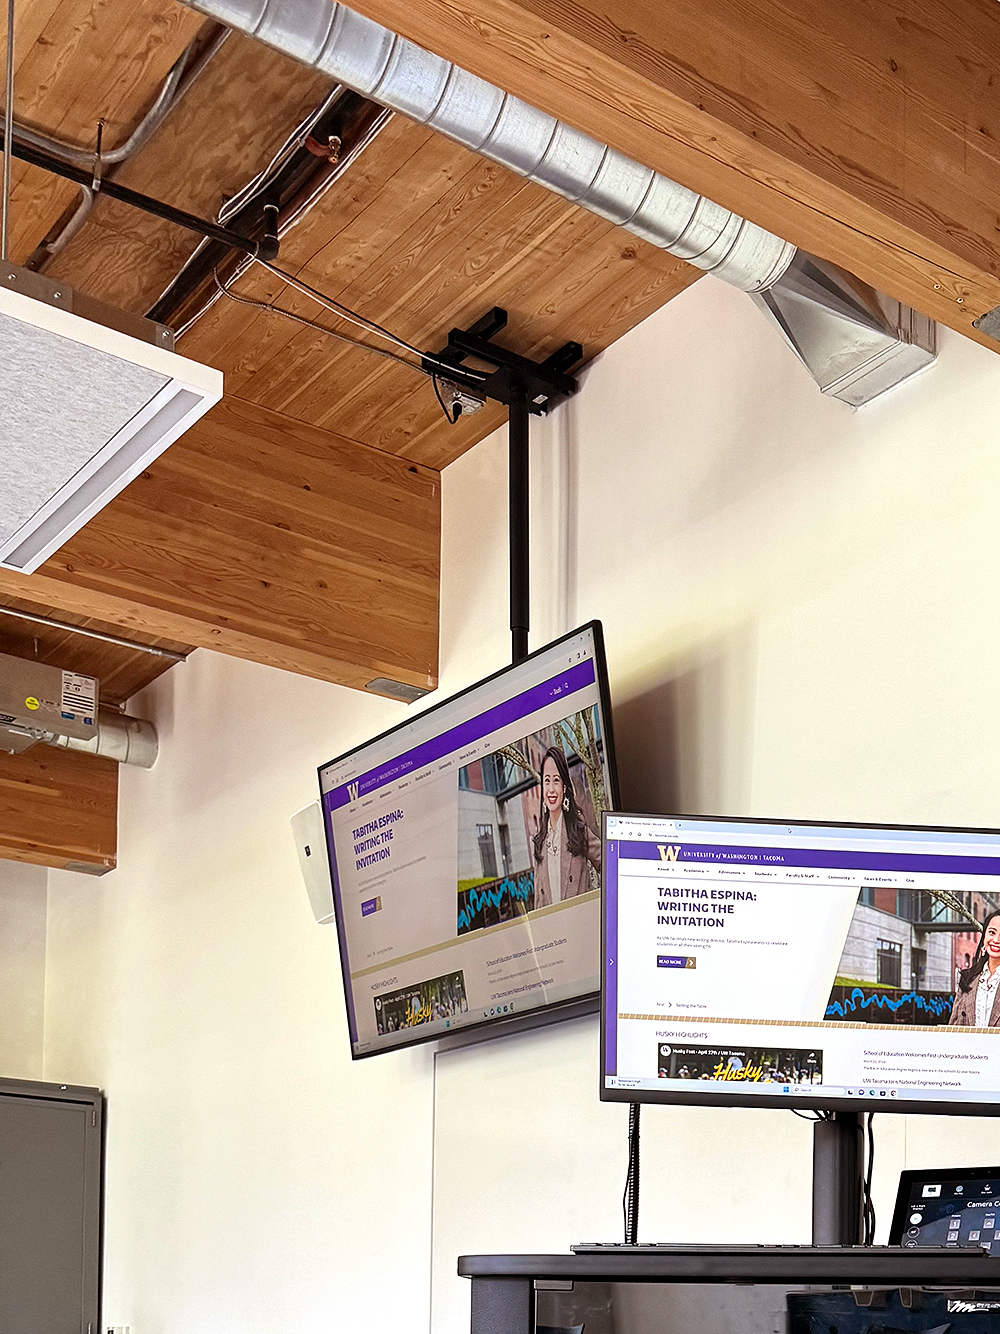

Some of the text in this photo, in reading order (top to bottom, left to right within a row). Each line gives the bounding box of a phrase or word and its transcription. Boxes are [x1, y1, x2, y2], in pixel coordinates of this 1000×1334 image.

[352, 809, 403, 840] TABITHA ESPINA:
[353, 828, 393, 855] WRITING THE
[356, 846, 390, 870] INVITATION
[656, 844, 681, 862] W
[657, 887, 756, 901] TABITHA ESPINA:
[657, 901, 734, 913] WRITING THE
[657, 915, 724, 927] INVITATION
[712, 1059, 763, 1082] Husky
